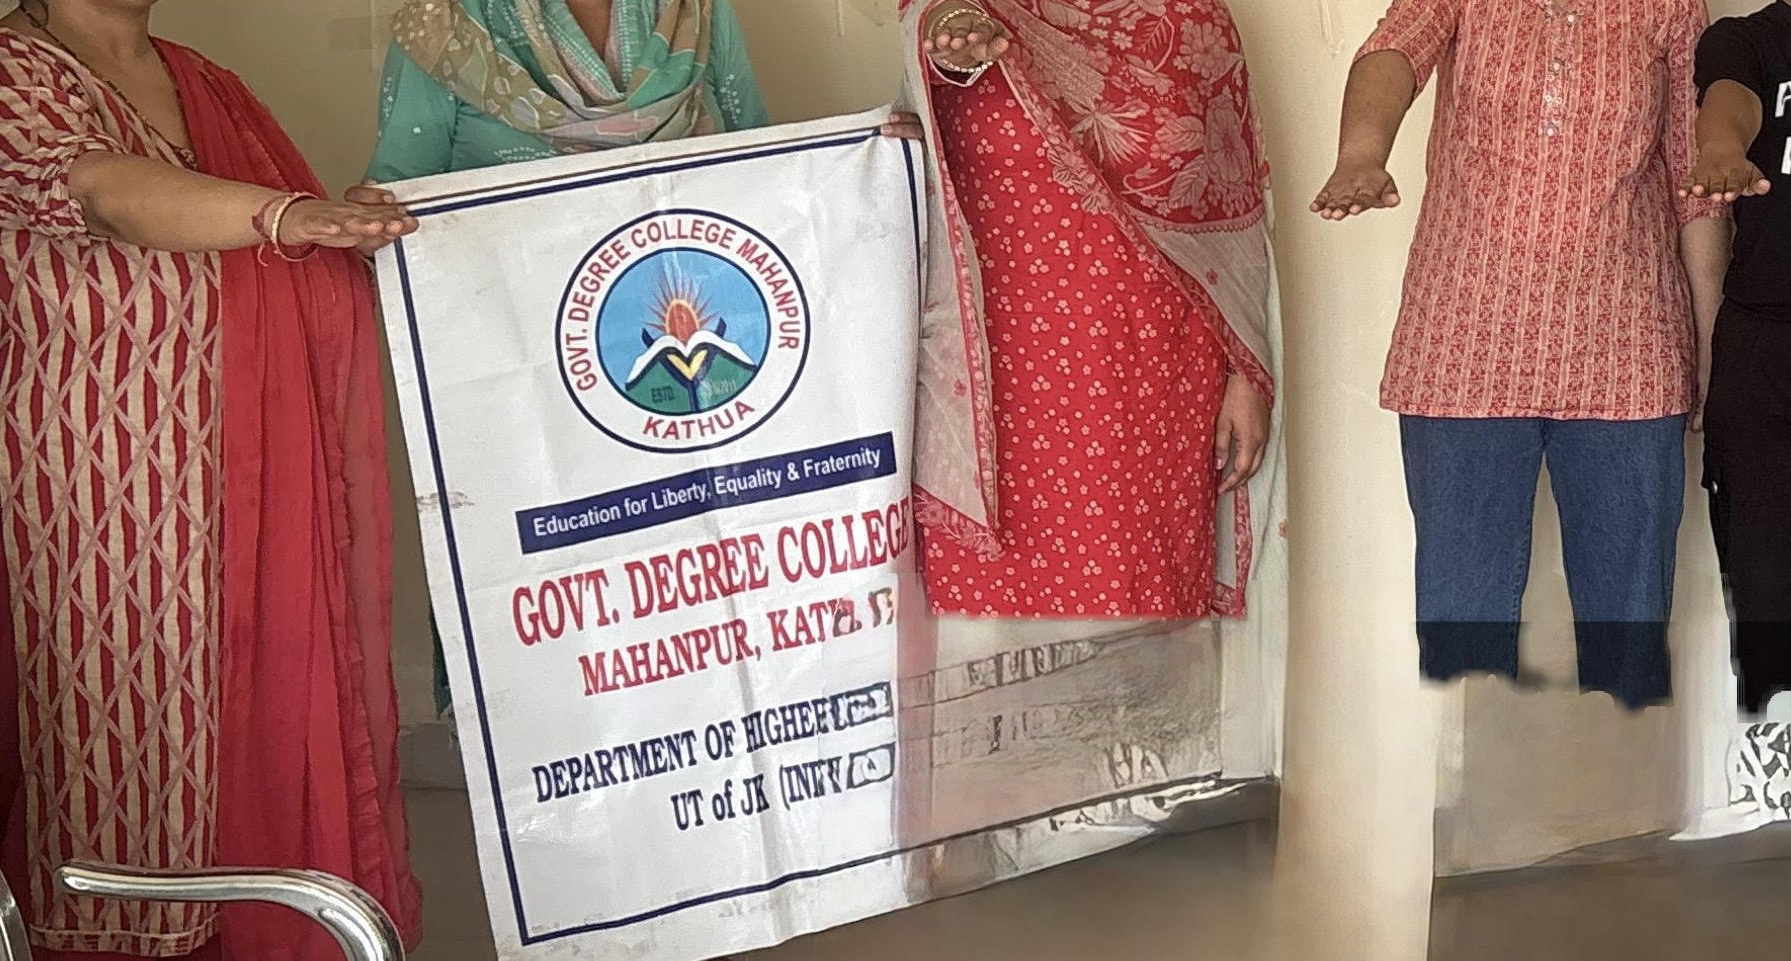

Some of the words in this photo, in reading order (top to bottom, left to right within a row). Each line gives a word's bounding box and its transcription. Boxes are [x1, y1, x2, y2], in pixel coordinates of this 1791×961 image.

[630, 219, 738, 250] COLLEGE
[568, 239, 632, 323] DEGREE
[735, 238, 801, 350] MAHANPUR
[565, 327, 598, 392] GOVT.
[642, 400, 755, 441] KATHUA
[534, 506, 623, 541] Education
[624, 498, 647, 516] for
[651, 483, 711, 509] Liberty,
[714, 469, 781, 495] Equality
[788, 463, 800, 480] &
[804, 448, 880, 477] Fraternity
[513, 569, 620, 646] GOVT.
[624, 534, 769, 619] DEGREE
[578, 618, 762, 696] MAHANPUR,
[532, 730, 697, 803] DEPARTMENT
[705, 721, 736, 761] OF
[671, 793, 704, 831] UT
[712, 784, 735, 820] of
[740, 775, 770, 816] JK
